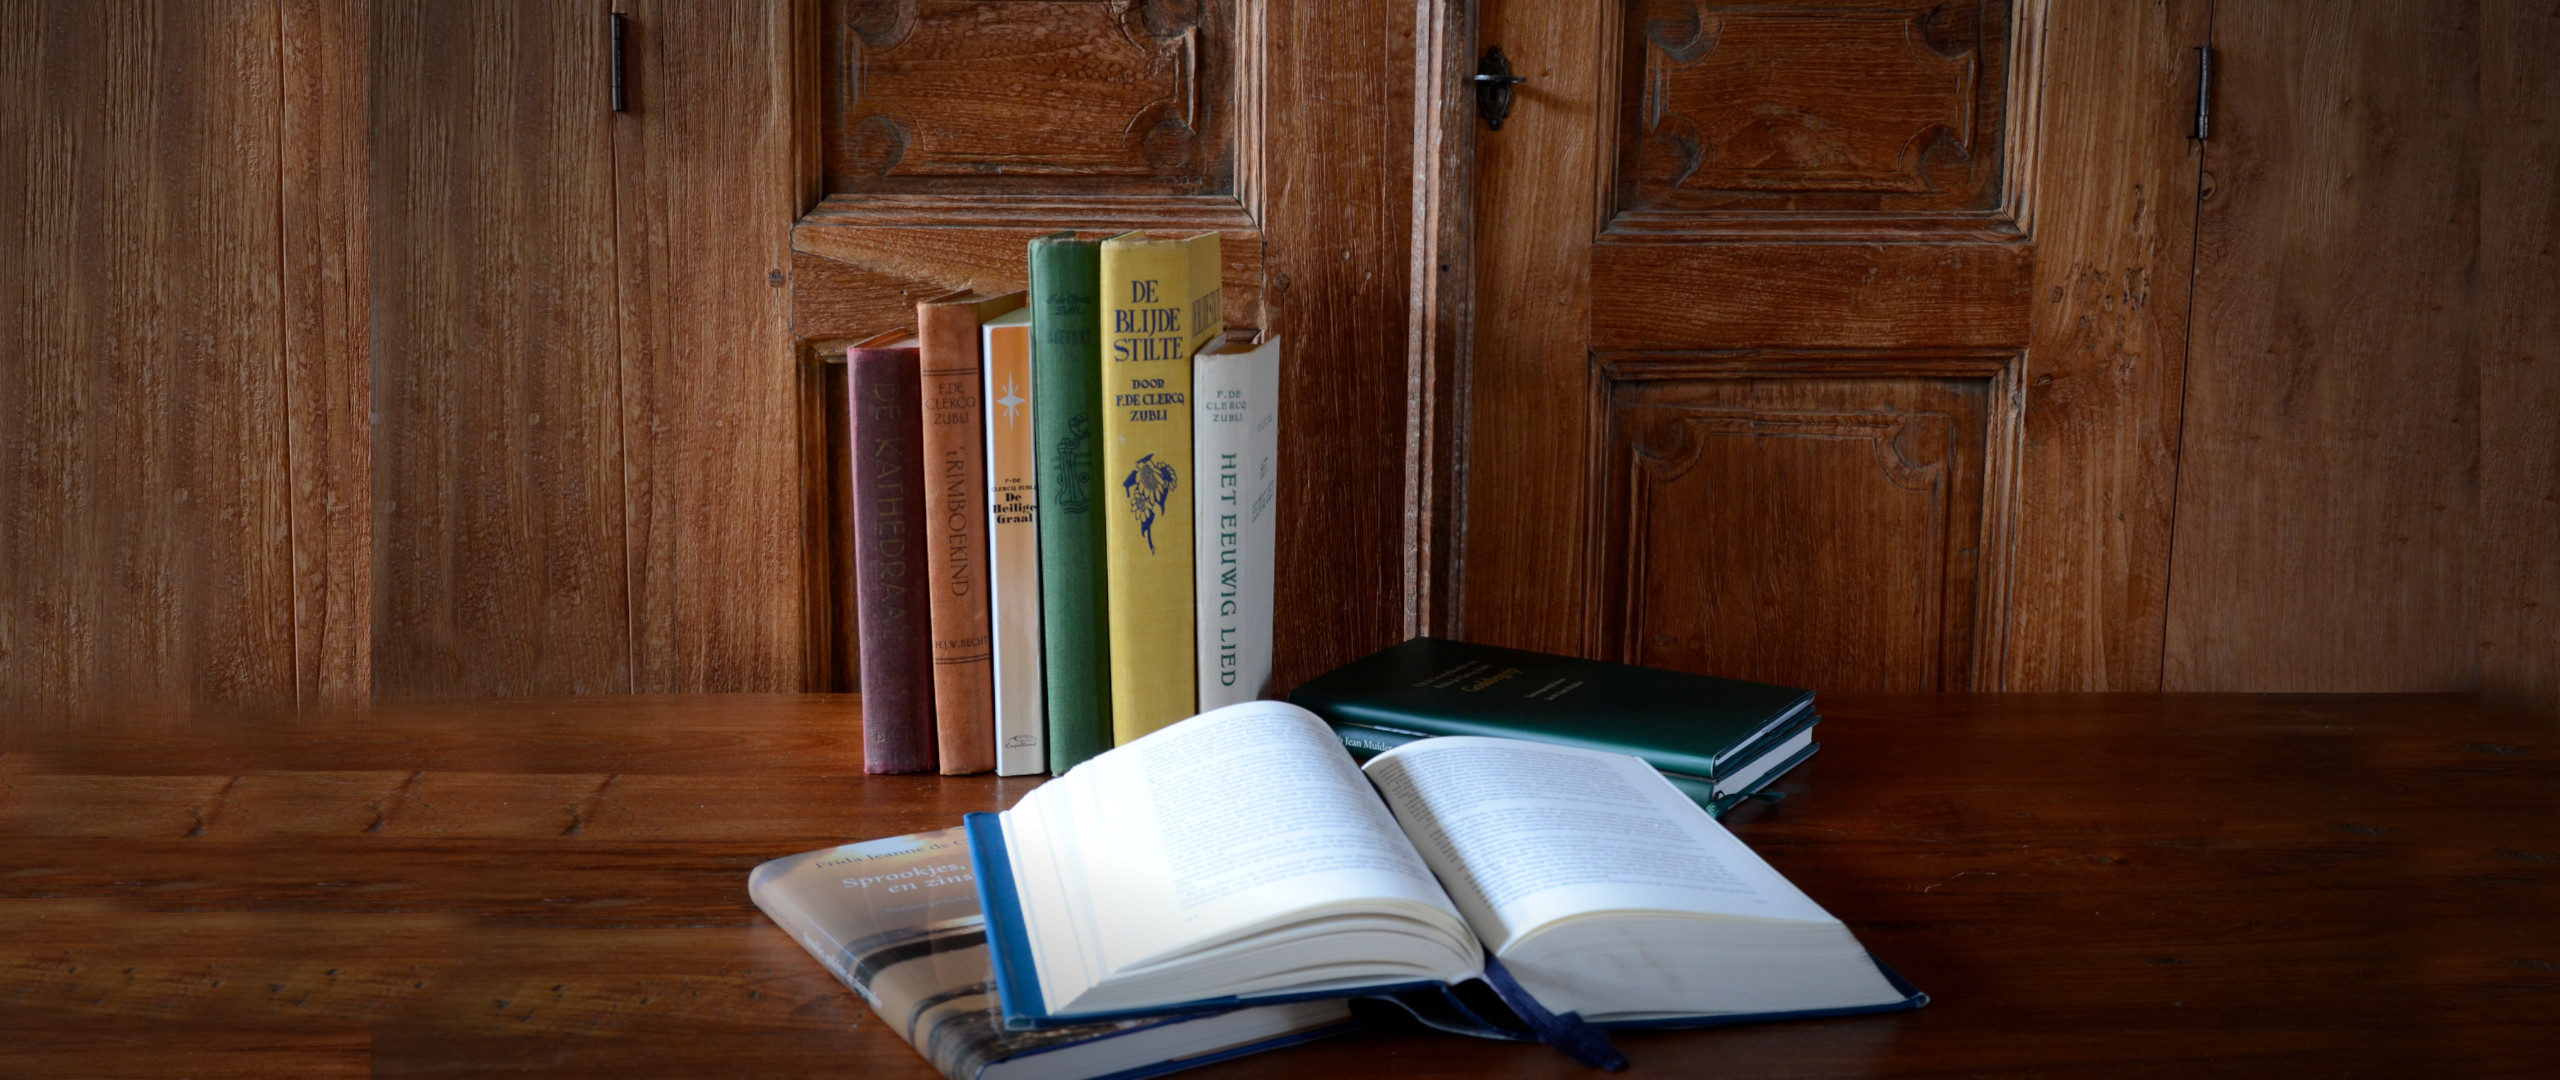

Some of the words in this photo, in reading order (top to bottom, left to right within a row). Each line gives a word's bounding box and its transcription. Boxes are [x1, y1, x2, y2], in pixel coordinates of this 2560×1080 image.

[1131, 279, 1159, 304] DE
[1114, 307, 1181, 337] BLIJDE
[1113, 336, 1184, 362] STILTE
[1131, 378, 1165, 390] DOOR
[873, 383, 902, 421] DE
[925, 396, 977, 410] CLERCQ
[1142, 393, 1185, 406] CLERCQ
[1206, 401, 1247, 411] CLERCQ
[934, 412, 970, 425] ZUBLI
[1130, 409, 1168, 422] ZUBLI
[1212, 413, 1243, 423] ZUBLI
[1221, 453, 1237, 505] HET
[1005, 492, 1022, 502] De
[992, 502, 1037, 514] Heilige
[996, 513, 1033, 524] Graal
[875, 438, 907, 640] KATHEDRAAL
[1221, 514, 1237, 617] EEUWIG
[1221, 627, 1237, 687] LIED
[1345, 736, 1362, 748] Jean
[1363, 739, 1393, 752] Mulder
[815, 856, 863, 869] Frida
[867, 847, 926, 862] Jeanne
[929, 841, 949, 851] de
[842, 863, 967, 889] Sprookjes,
[888, 881, 918, 893] en
